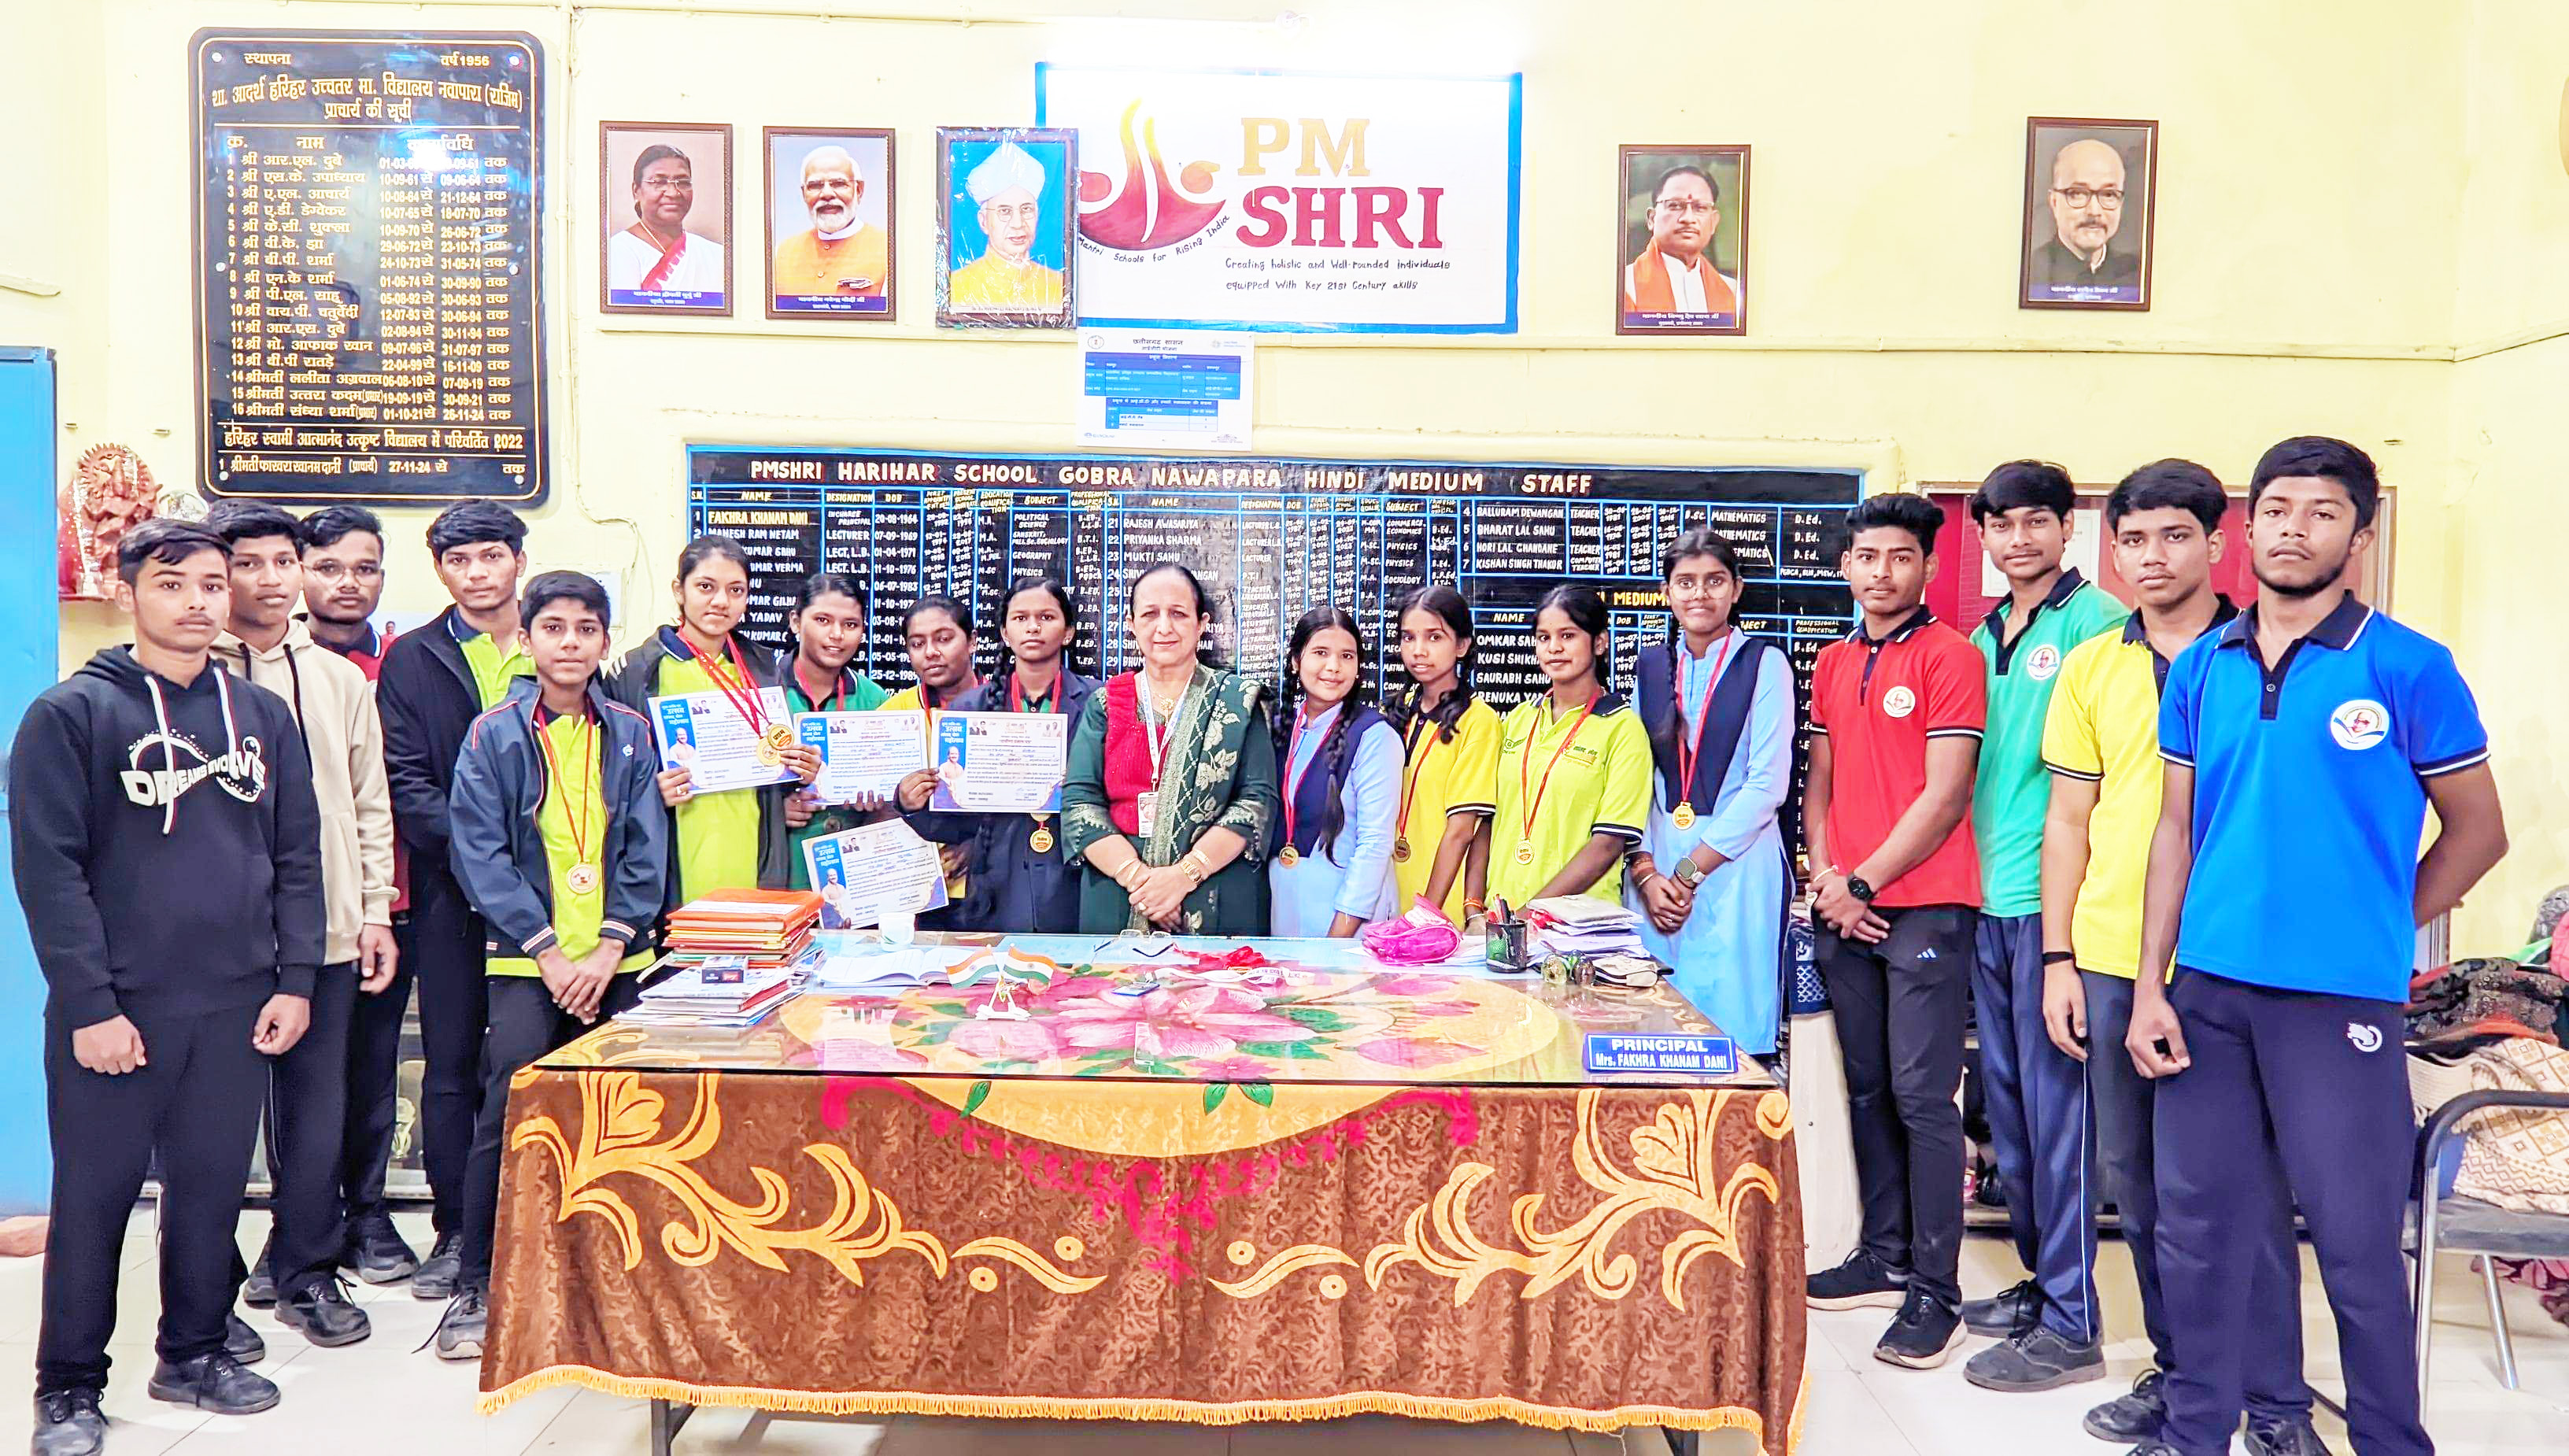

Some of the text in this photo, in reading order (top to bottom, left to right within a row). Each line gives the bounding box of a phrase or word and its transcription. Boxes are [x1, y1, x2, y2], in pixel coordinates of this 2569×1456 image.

[243, 53, 291, 65] स्थापना
[441, 51, 490, 66] वर्ष 1956
[232, 75, 267, 103] आदर्श
[269, 74, 306, 101] हरिहर
[311, 79, 353, 94] उच्चतर
[358, 78, 377, 94] मा.
[383, 71, 433, 97] विद्यालय
[438, 81, 482, 102] नवापारा
[485, 83, 523, 113] (राजिम)
[324, 97, 412, 123] प्राचार्य की सूची
[296, 137, 324, 149] नाम
[1236, 117, 1370, 177] PM
[227, 169, 235, 182] 2
[242, 168, 257, 182] श्री
[312, 172, 365, 183] उपाध्याय
[484, 174, 508, 184] तक
[1236, 185, 1444, 249] SHRI
[1078, 236, 1104, 256] Mantri
[1114, 253, 1144, 263] Schools
[1152, 253, 1166, 262] for
[1205, 214, 1230, 238] India
[1225, 257, 1265, 272] Creating
[1271, 258, 1302, 269] holistic
[1307, 259, 1325, 269] and
[1331, 258, 1389, 269] Well-rounded
[229, 269, 335, 284] 8 श्री शर्मा
[485, 277, 508, 287] तक
[1225, 279, 1270, 292] equipped
[1275, 279, 1297, 290] With
[1305, 280, 1321, 291] Key
[1327, 281, 1347, 290] 21st
[1352, 280, 1386, 291] Century
[230, 287, 237, 299] 9
[244, 286, 260, 300] श्री
[266, 286, 308, 303] पी.एल.
[486, 294, 508, 304] तक
[244, 302, 261, 316] श्री
[318, 304, 359, 321] चतुर्वेदी
[486, 310, 509, 320] तक
[245, 336, 373, 351] श्री मो. आफाक खान
[442, 343, 510, 356] 31-07-97 तक
[246, 369, 383, 385] श्रीमती ललीता अग्रवाल
[442, 377, 511, 390] 07-09-19 तक
[246, 402, 323, 416] श्रीमती संध्या
[442, 409, 512, 421] 26-11-24 तक
[224, 427, 523, 452] हरिहर स्वामी आत्मानंद उत्कृष्ट विद्यालय में परिवर्तित 2022
[231, 455, 259, 472] श्रीमती
[388, 461, 431, 473] 27-11-24
[434, 459, 448, 472] से
[750, 460, 1591, 495] PMSHRI HARIHAR SCHOOL GOBRA NAWAPARA HINDI MEDIUM STAFF
[741, 491, 903, 503] NAME DESIGNATION DOB
[1151, 497, 1179, 507] NAME
[1385, 501, 1419, 512] SUBJECT
[708, 511, 749, 524] FAKHRA
[750, 512, 789, 525] KHANAM
[874, 514, 995, 526] 20-08-1964 M.A.
[1521, 508, 1599, 519] DEWANGAN TEACHER
[1711, 512, 1822, 525] MATHEMATICS D.Ed.
[1107, 518, 1118, 529] 21
[1123, 518, 1154, 529] RAJESH
[1477, 524, 1555, 536] BHARAT LAL SAHU
[748, 529, 918, 541] RAM NETAM LECTURER 07-09-1969
[1107, 536, 1202, 546] 22 PRIYANKA SHARMA
[874, 548, 916, 557] 01-04-1971
[1477, 542, 1495, 552] HORI
[1497, 542, 1513, 553] LAL
[1012, 552, 1052, 560] GEOGRAPHY
[1107, 552, 1181, 562] 23 MUKTI SAHU
[775, 563, 917, 575] VERMA 11-10-1976
[1476, 558, 1532, 569] KISHAN SINGH
[1012, 568, 1044, 577] PHYSICS
[1613, 592, 1665, 607] MEDIUM
[750, 613, 783, 623] YADAV
[1493, 613, 1525, 623] NAME
[1616, 616, 1632, 625] DOB
[1477, 634, 1517, 647] OMKAR
[1794, 641, 1820, 653] B.Ed.
[1476, 672, 1551, 685] SAURABH SAHU
[120, 763, 208, 807] DREAMS
[1611, 1038, 1709, 1053] PRINCIPAL
[1595, 1053, 1727, 1070] Mrs. FAKHRA KHANAM DANI
